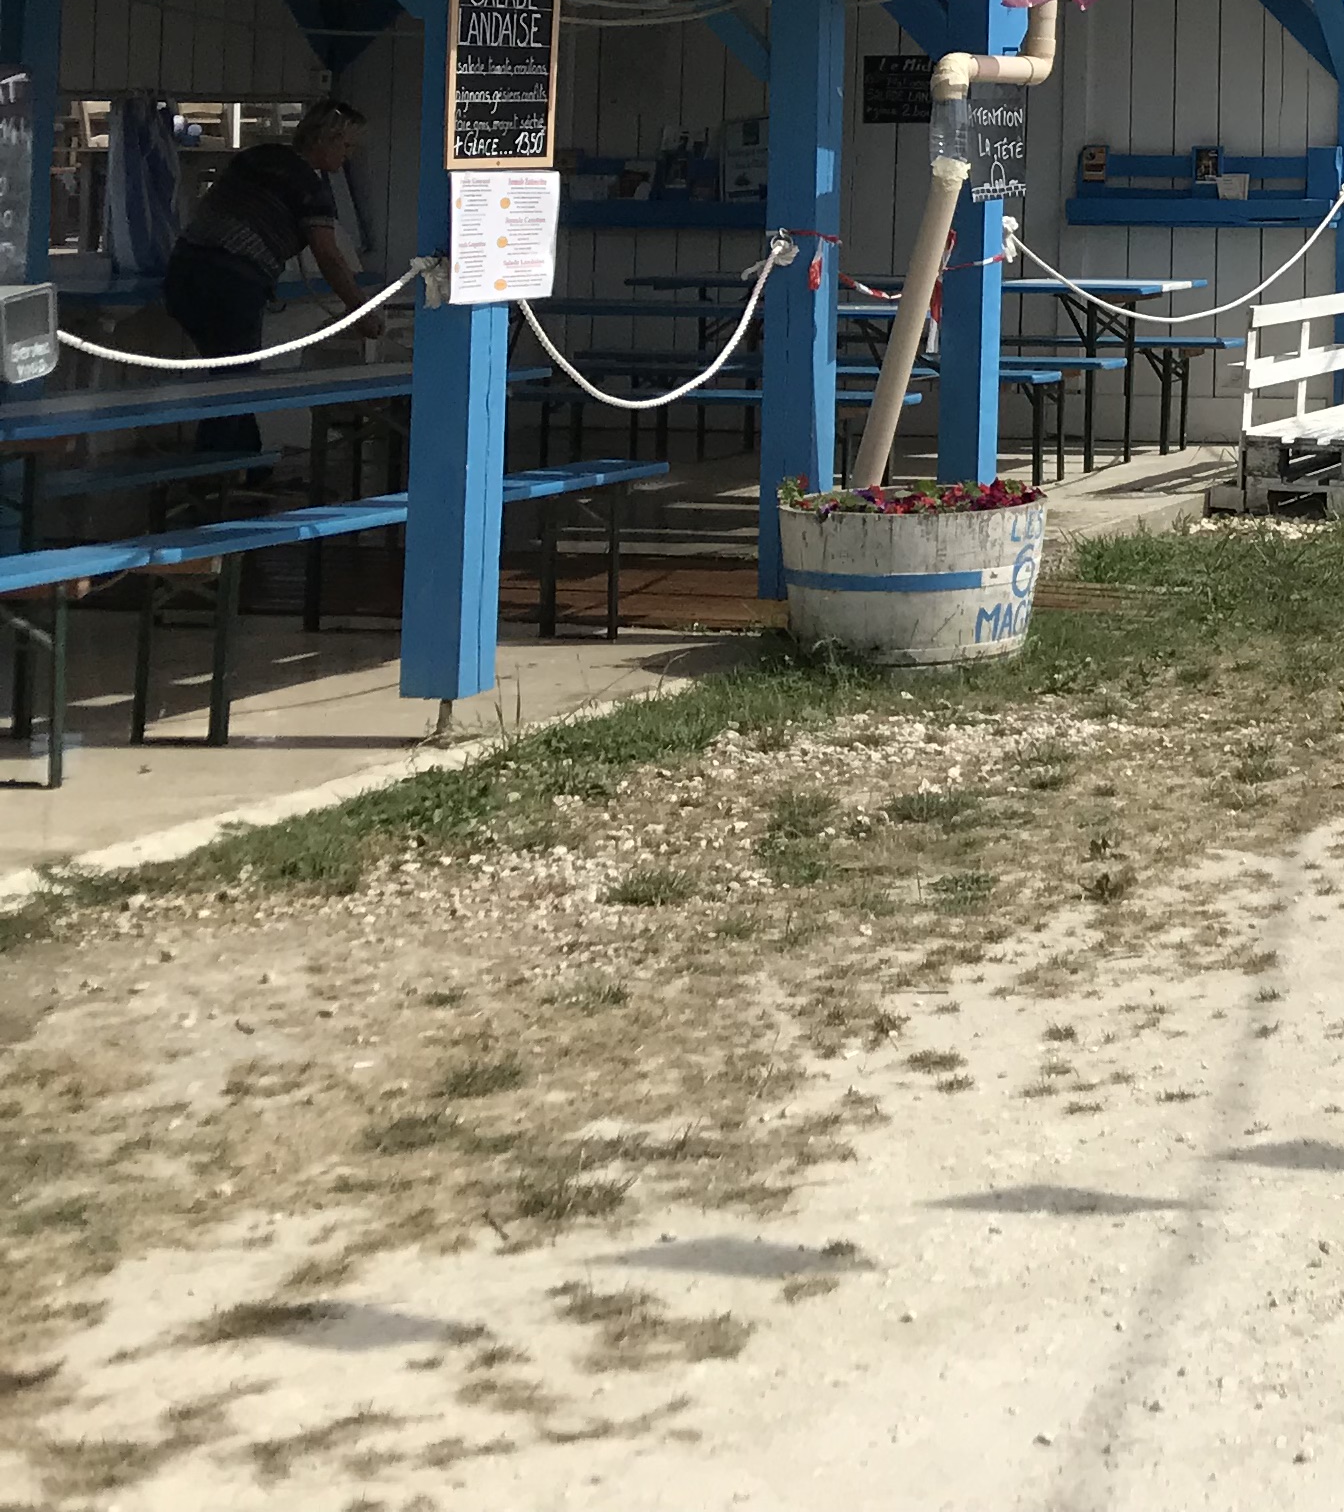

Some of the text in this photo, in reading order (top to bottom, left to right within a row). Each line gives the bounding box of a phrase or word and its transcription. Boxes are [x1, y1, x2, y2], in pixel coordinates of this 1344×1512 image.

[458, 7, 542, 48] LANDAISE
[967, 103, 1024, 128] ATTENTION
[978, 133, 991, 157] LA
[1011, 543, 1036, 599] 6
